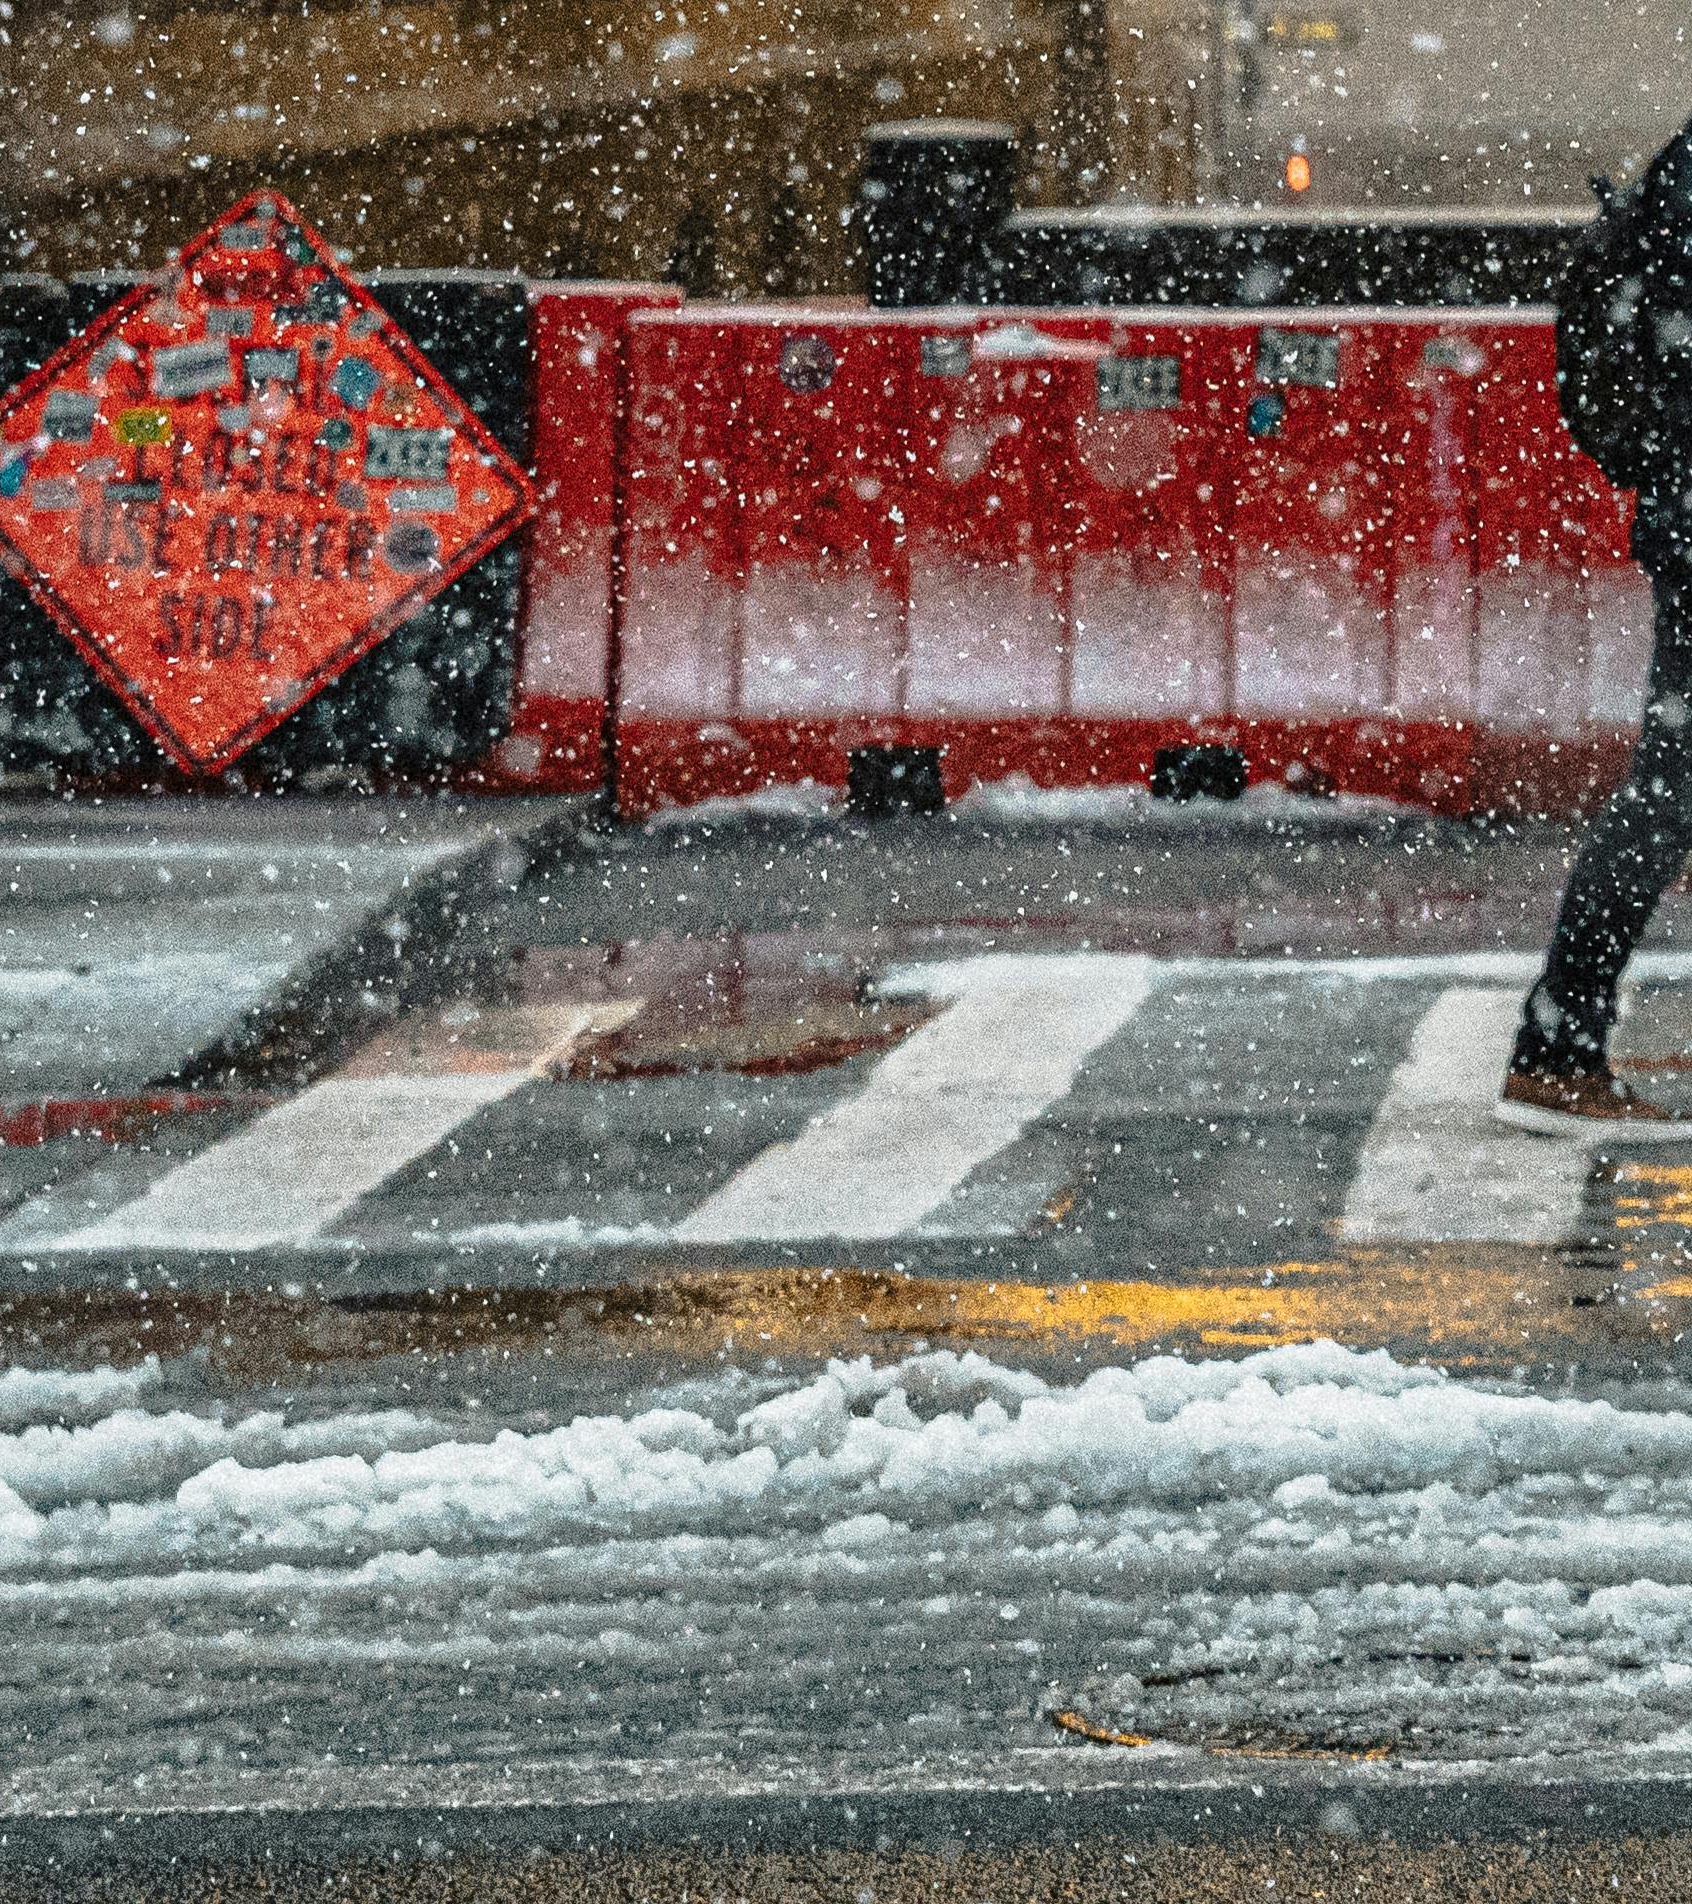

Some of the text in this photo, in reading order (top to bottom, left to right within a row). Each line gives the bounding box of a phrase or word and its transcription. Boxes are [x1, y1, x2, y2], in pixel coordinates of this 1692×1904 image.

[78, 499, 377, 584] USE OTHER
[158, 592, 276, 664] SIDE
